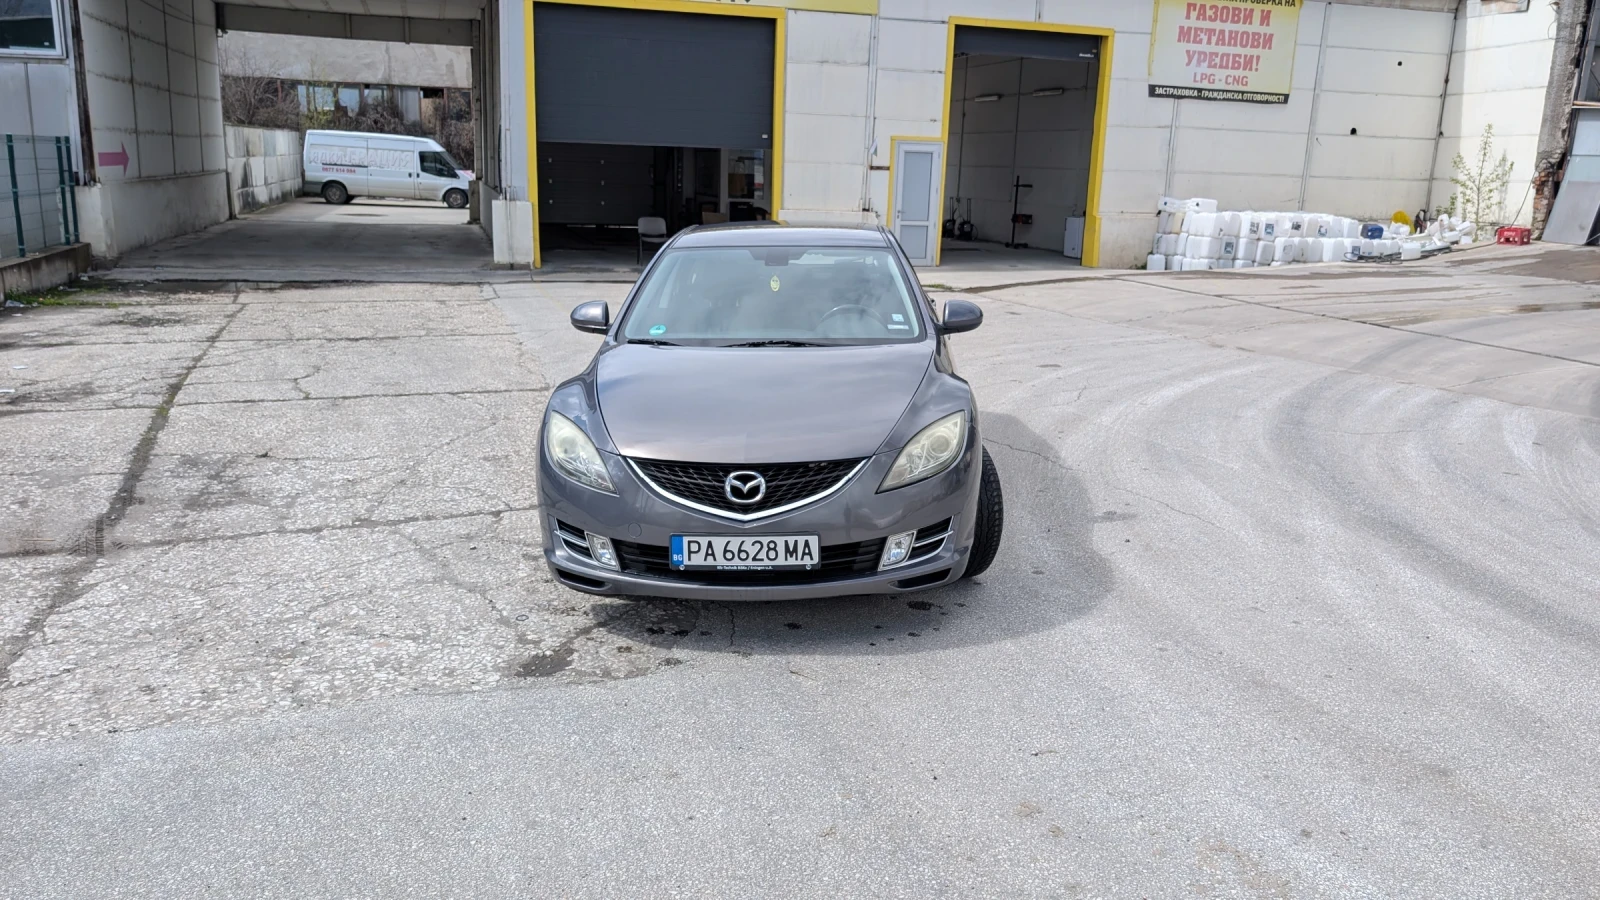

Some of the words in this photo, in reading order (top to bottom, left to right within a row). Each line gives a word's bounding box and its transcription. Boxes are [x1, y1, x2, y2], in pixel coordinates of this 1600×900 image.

[1185, 2, 1254, 25] ГАЗОВИ
[1259, 9, 1272, 27] И
[1177, 25, 1274, 50] МЕТАНОВИ
[1185, 49, 1261, 72] УРЕДБИ!
[1193, 72, 1215, 84] LPG
[1224, 74, 1249, 86] CNG
[1154, 87, 1198, 97] ЗАСТРАХОВКА
[1201, 90, 1242, 100] ГРАЖДАНСКА
[1243, 93, 1285, 103] ОТГОВОРНОСТ!
[687, 540, 717, 562] PA
[723, 540, 778, 562] 6628
[785, 539, 814, 561] MA
